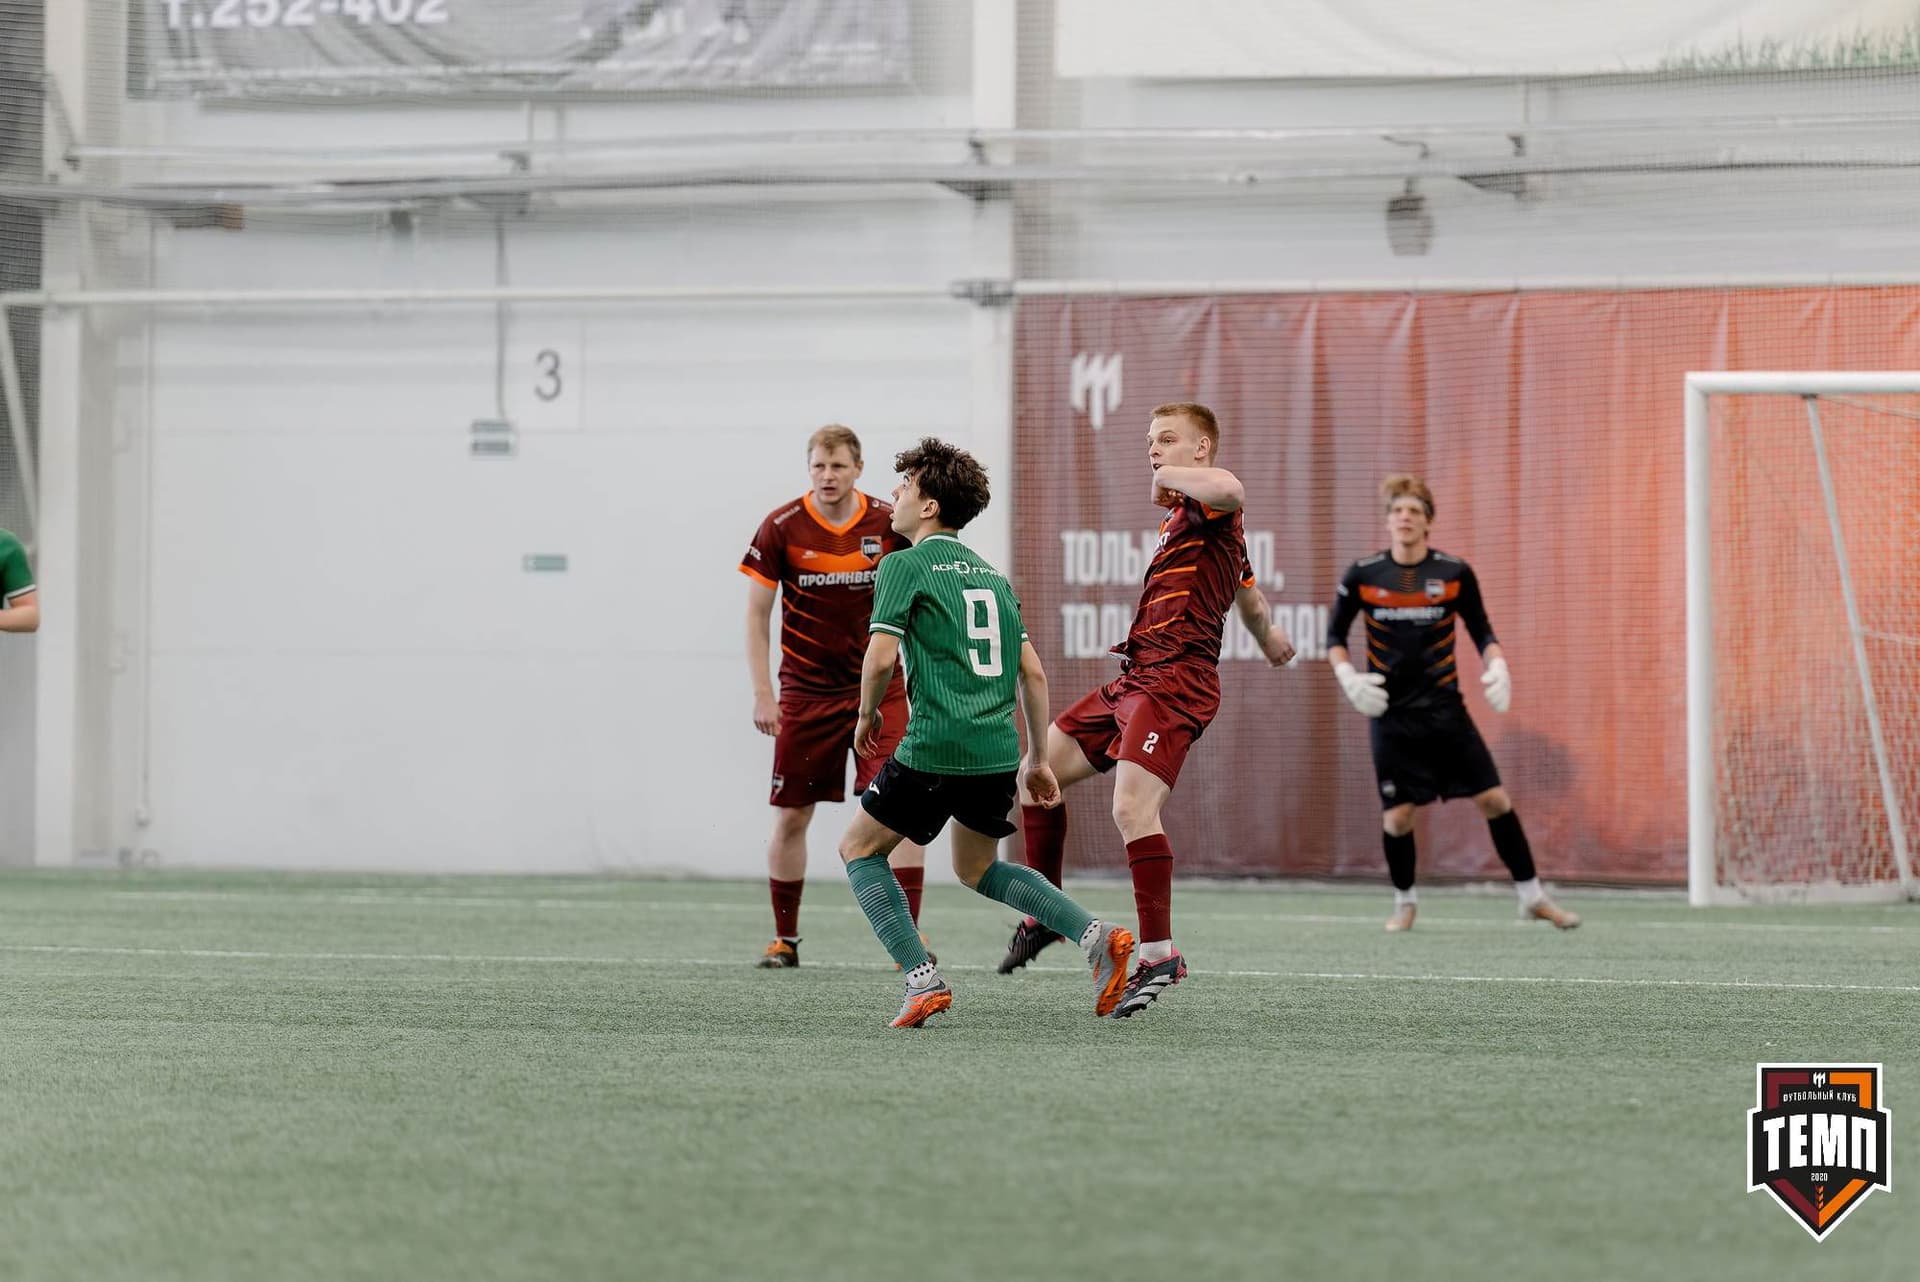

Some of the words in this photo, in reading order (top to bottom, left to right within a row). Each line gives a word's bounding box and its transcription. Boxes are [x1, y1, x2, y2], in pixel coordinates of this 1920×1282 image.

[534, 349, 562, 401] 3
[962, 588, 1003, 676] 9
[1142, 731, 1160, 755] 2
